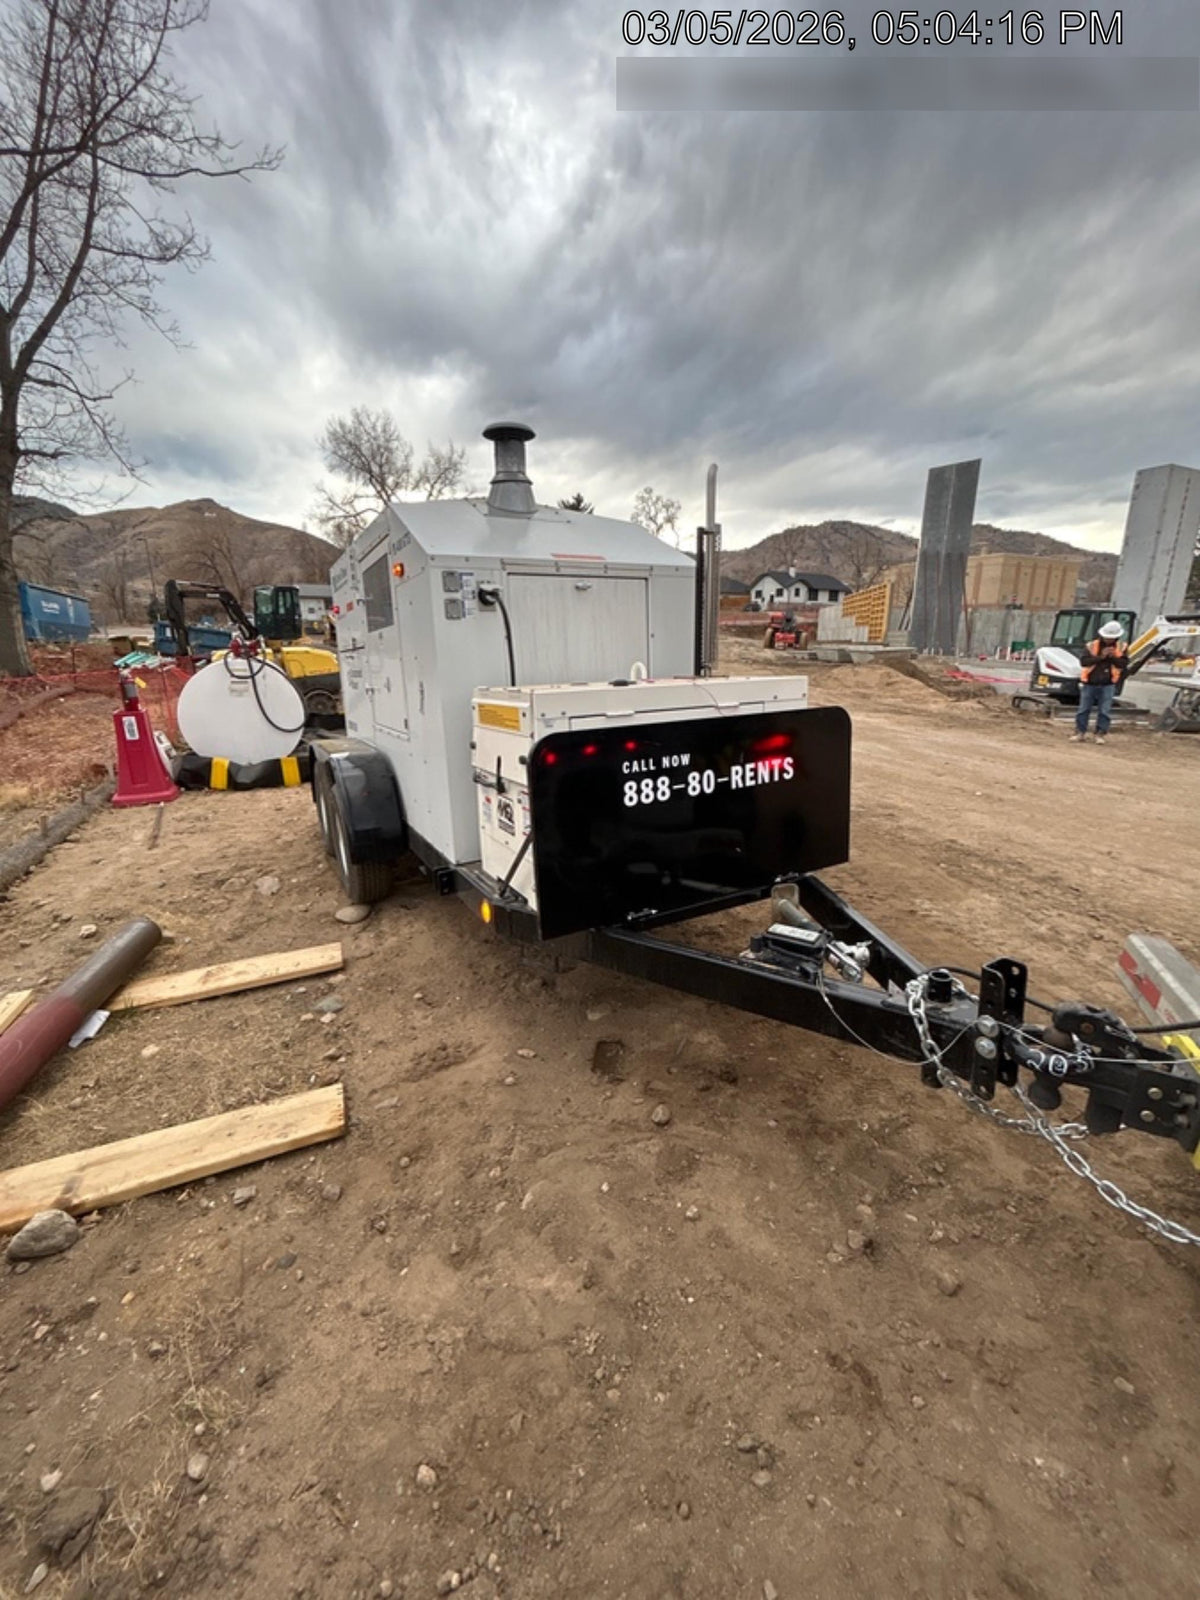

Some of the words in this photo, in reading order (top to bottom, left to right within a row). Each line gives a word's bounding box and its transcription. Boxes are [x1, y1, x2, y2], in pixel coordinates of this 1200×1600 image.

[622, 758, 656, 774] CALL
[662, 753, 691, 769] NOW
[623, 756, 794, 807] 888-80-RENTS
